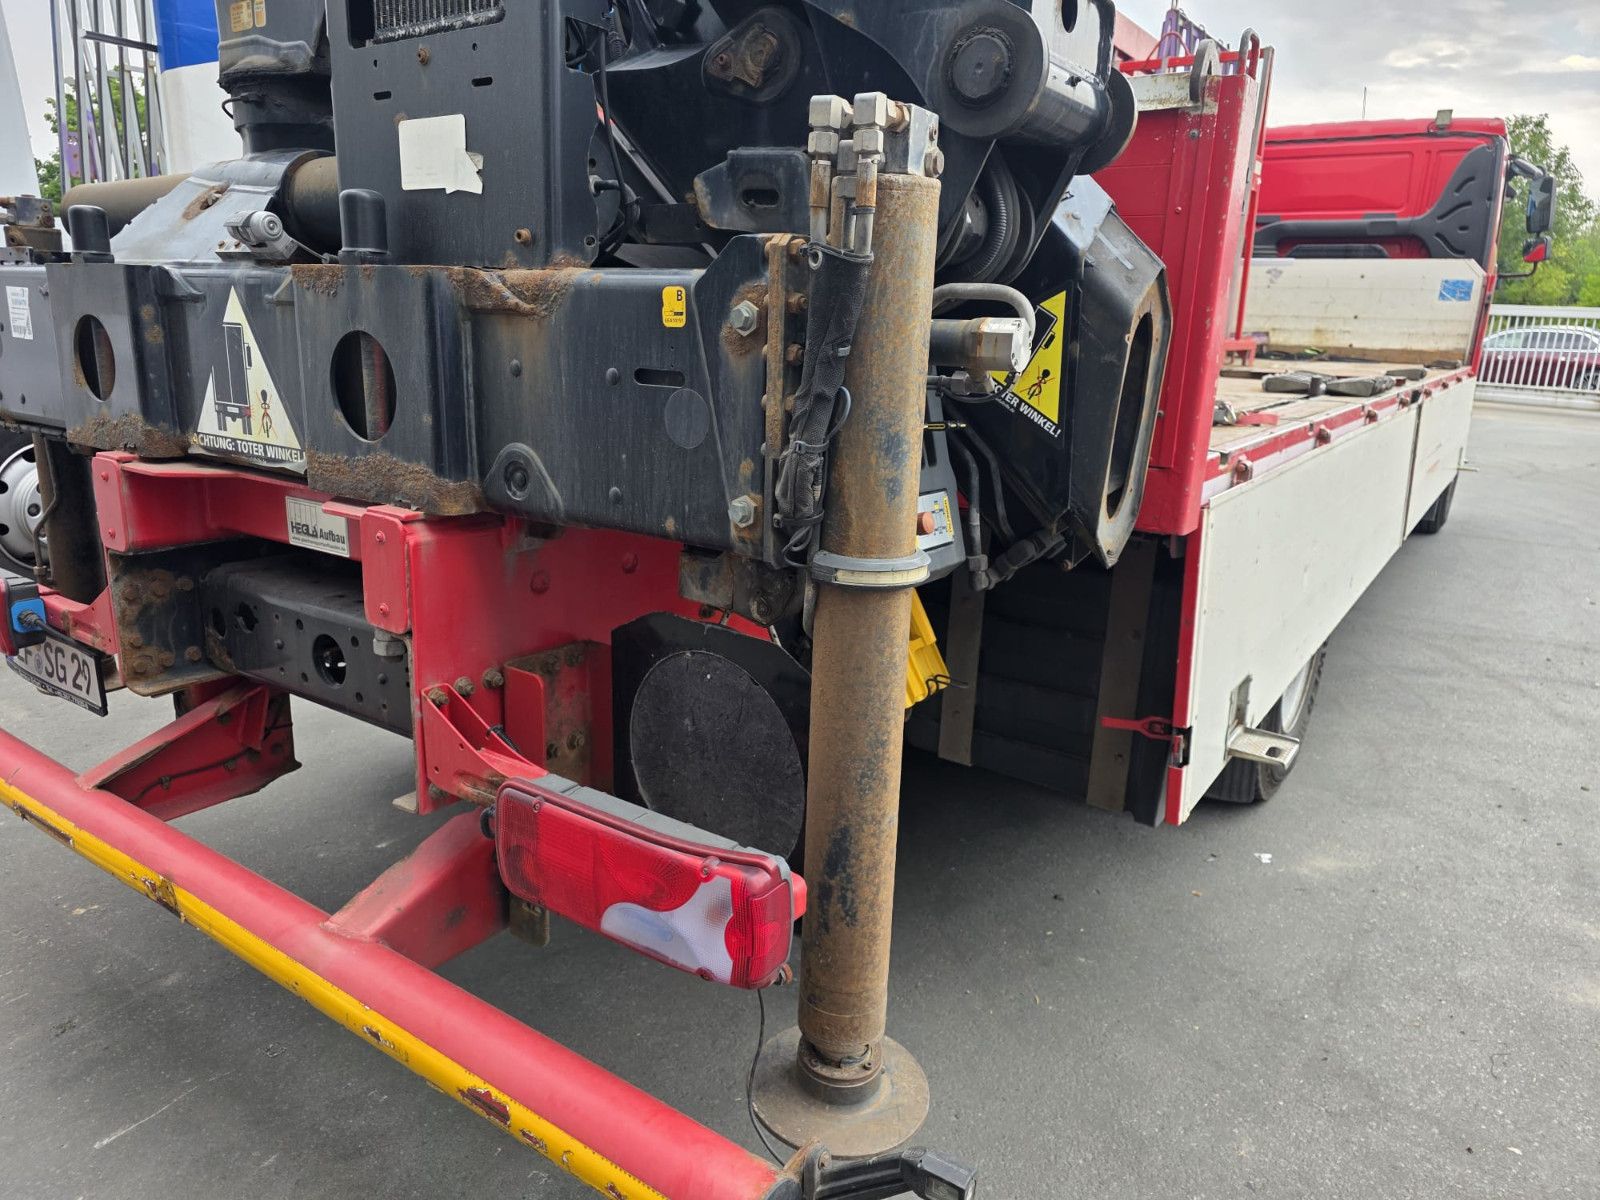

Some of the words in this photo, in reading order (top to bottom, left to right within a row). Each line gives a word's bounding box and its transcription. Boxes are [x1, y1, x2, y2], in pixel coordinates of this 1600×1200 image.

[676, 290, 683, 301] B
[1019, 402, 1061, 438] WINKEL!
[191, 433, 235, 451] ACHTUNG:
[237, 440, 265, 457] TOTER
[320, 528, 346, 545] Aufbau
[43, 641, 68, 686] SG
